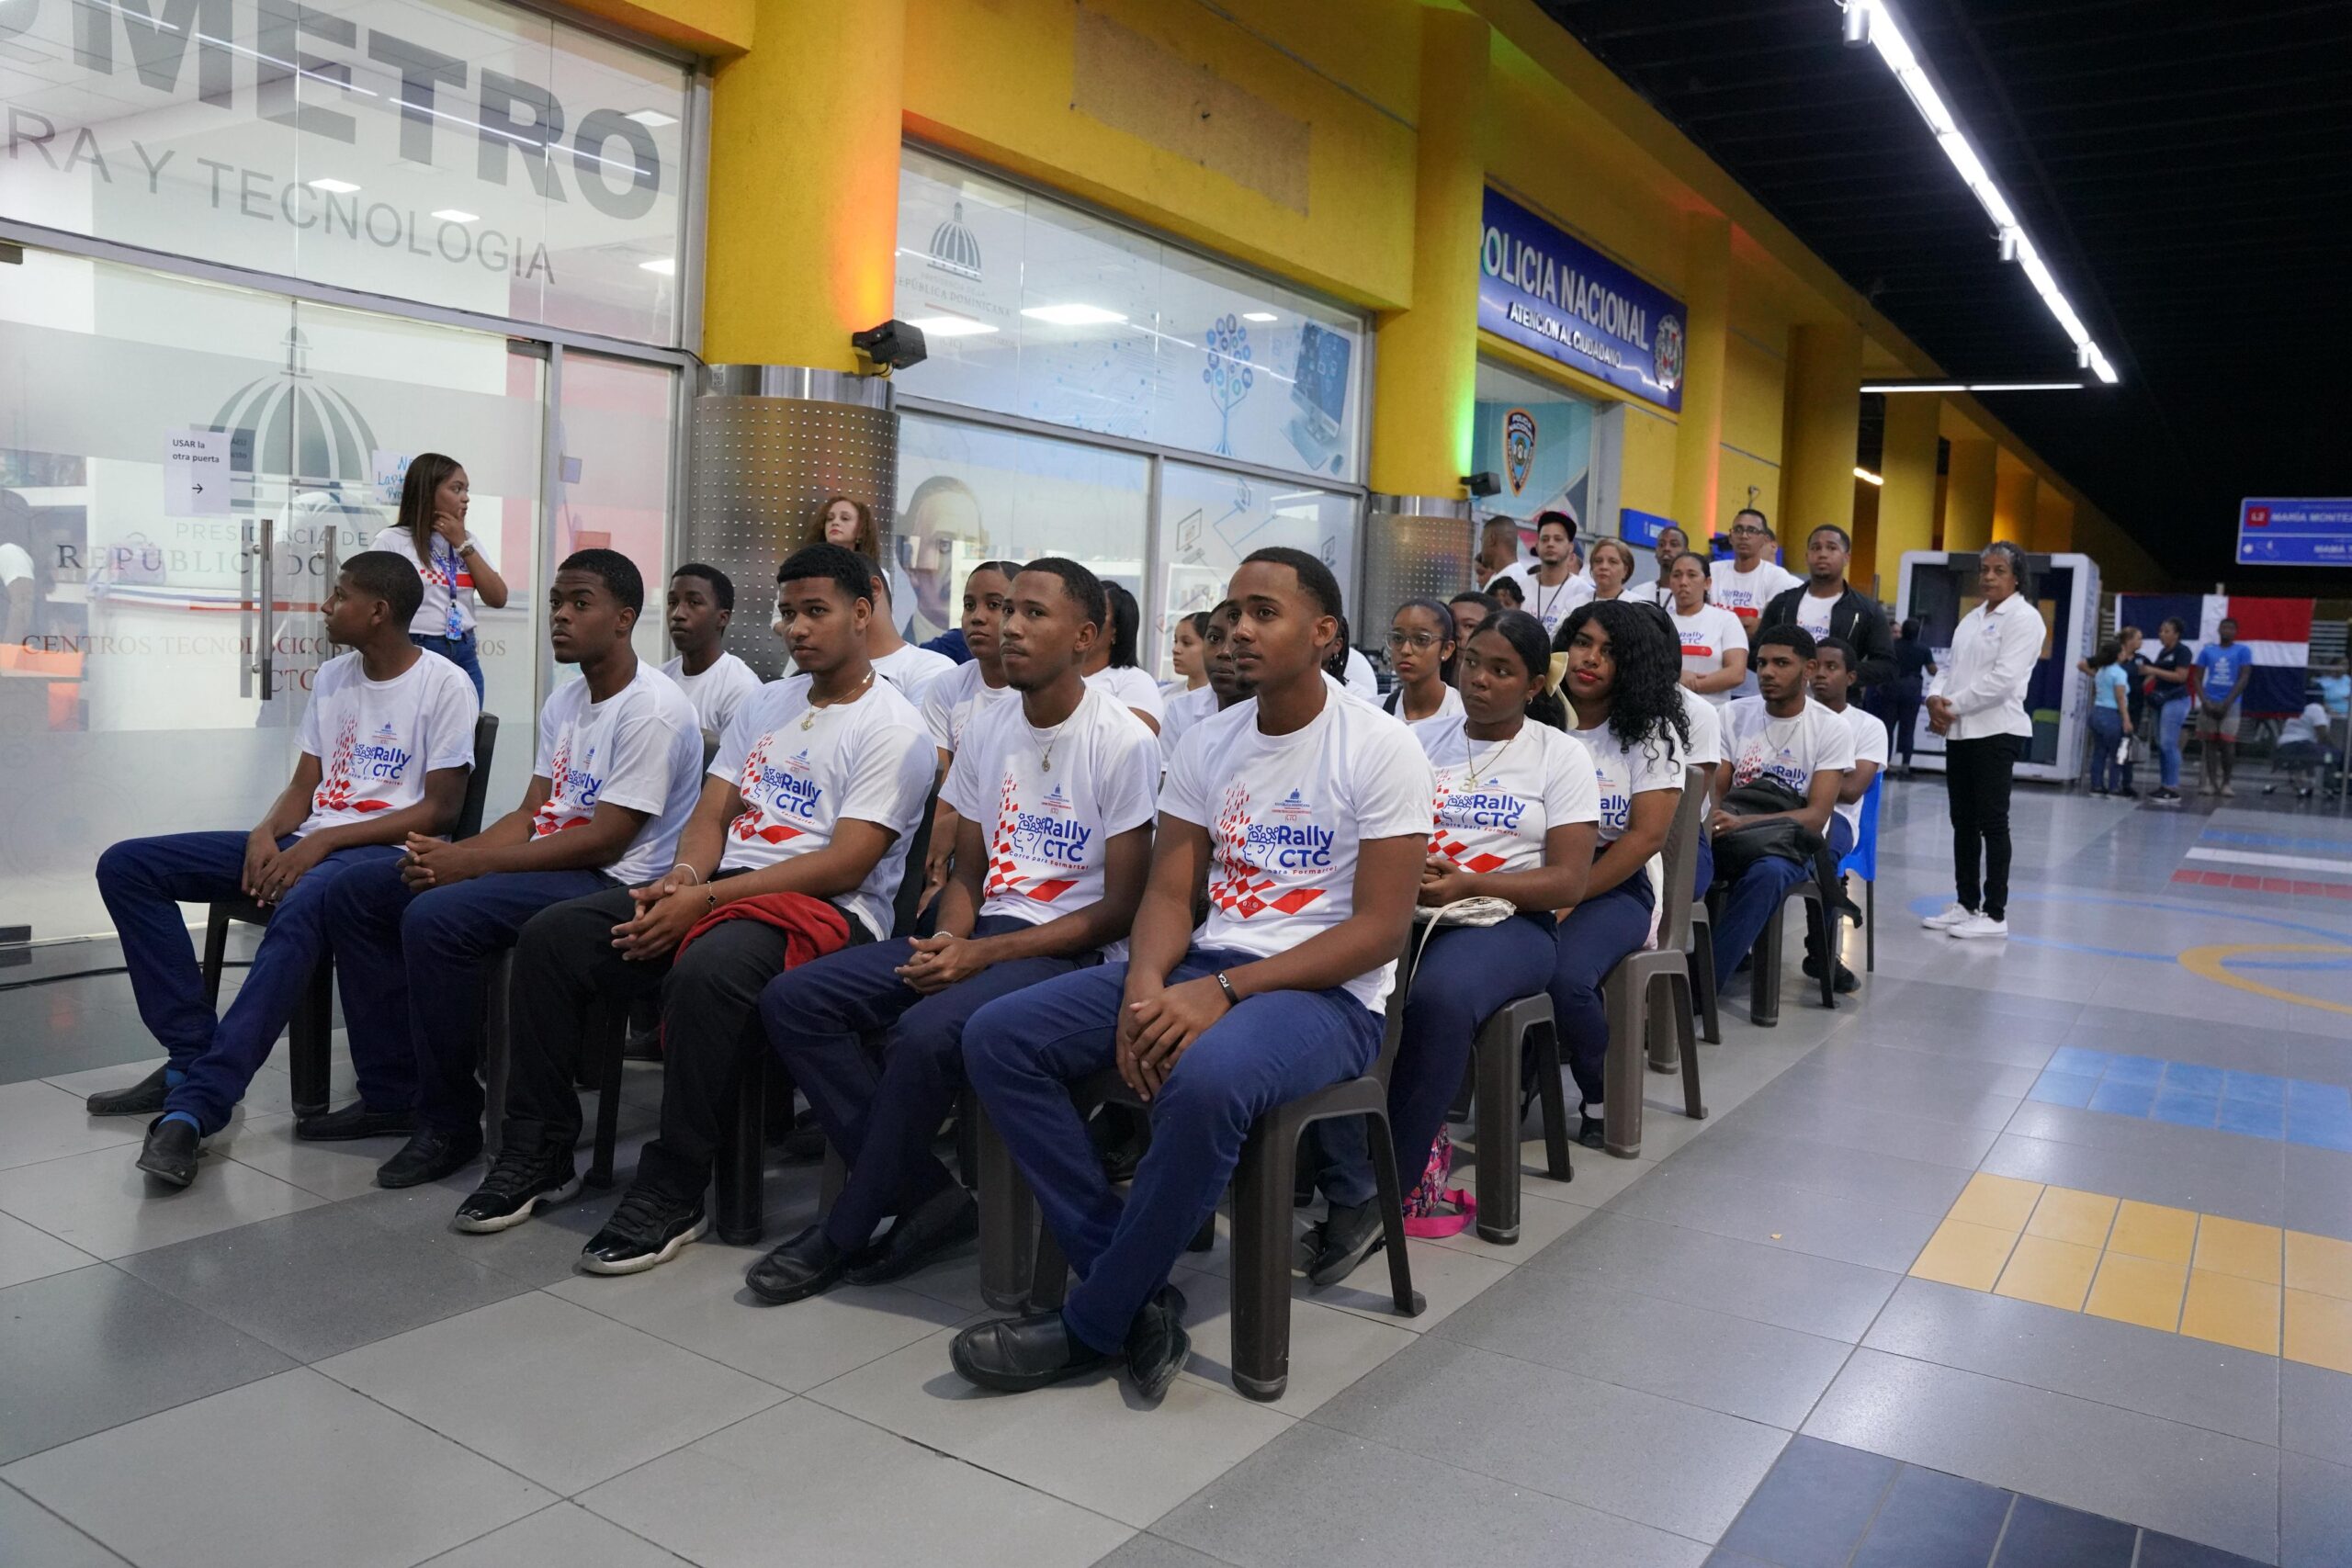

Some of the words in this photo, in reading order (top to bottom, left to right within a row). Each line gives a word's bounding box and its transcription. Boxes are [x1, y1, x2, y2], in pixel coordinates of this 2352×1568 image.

[0, 0, 661, 220] METRO
[131, 140, 176, 194] Y
[197, 157, 556, 285] TECNOLOGIA
[1480, 221, 1557, 305] OLICIA
[1561, 265, 1650, 351] NACIONAL
[1510, 301, 1558, 342] ATENCION
[1559, 324, 1572, 346] AL
[1573, 331, 1622, 368] CIUDADANO
[172, 439, 196, 448] USAR
[198, 440, 205, 449] la
[172, 453, 190, 461] otra
[192, 455, 220, 463] puerta
[342, 531, 368, 547] DE
[22, 635, 152, 654] CENTROS
[373, 746, 413, 768] Rally
[372, 763, 403, 780] CTC
[1776, 765, 1807, 783] Rally
[780, 773, 823, 805] Rally
[775, 793, 816, 818] CTC
[1473, 795, 1526, 817] Rally
[1600, 795, 1631, 815] ally
[1474, 811, 1520, 829] CTC
[1601, 812, 1627, 826] TC
[1044, 817, 1091, 846] Rally
[1277, 825, 1334, 851] Rally
[1009, 851, 1030, 860] Corre
[1044, 839, 1084, 863] CTC
[1279, 849, 1331, 868] CTC
